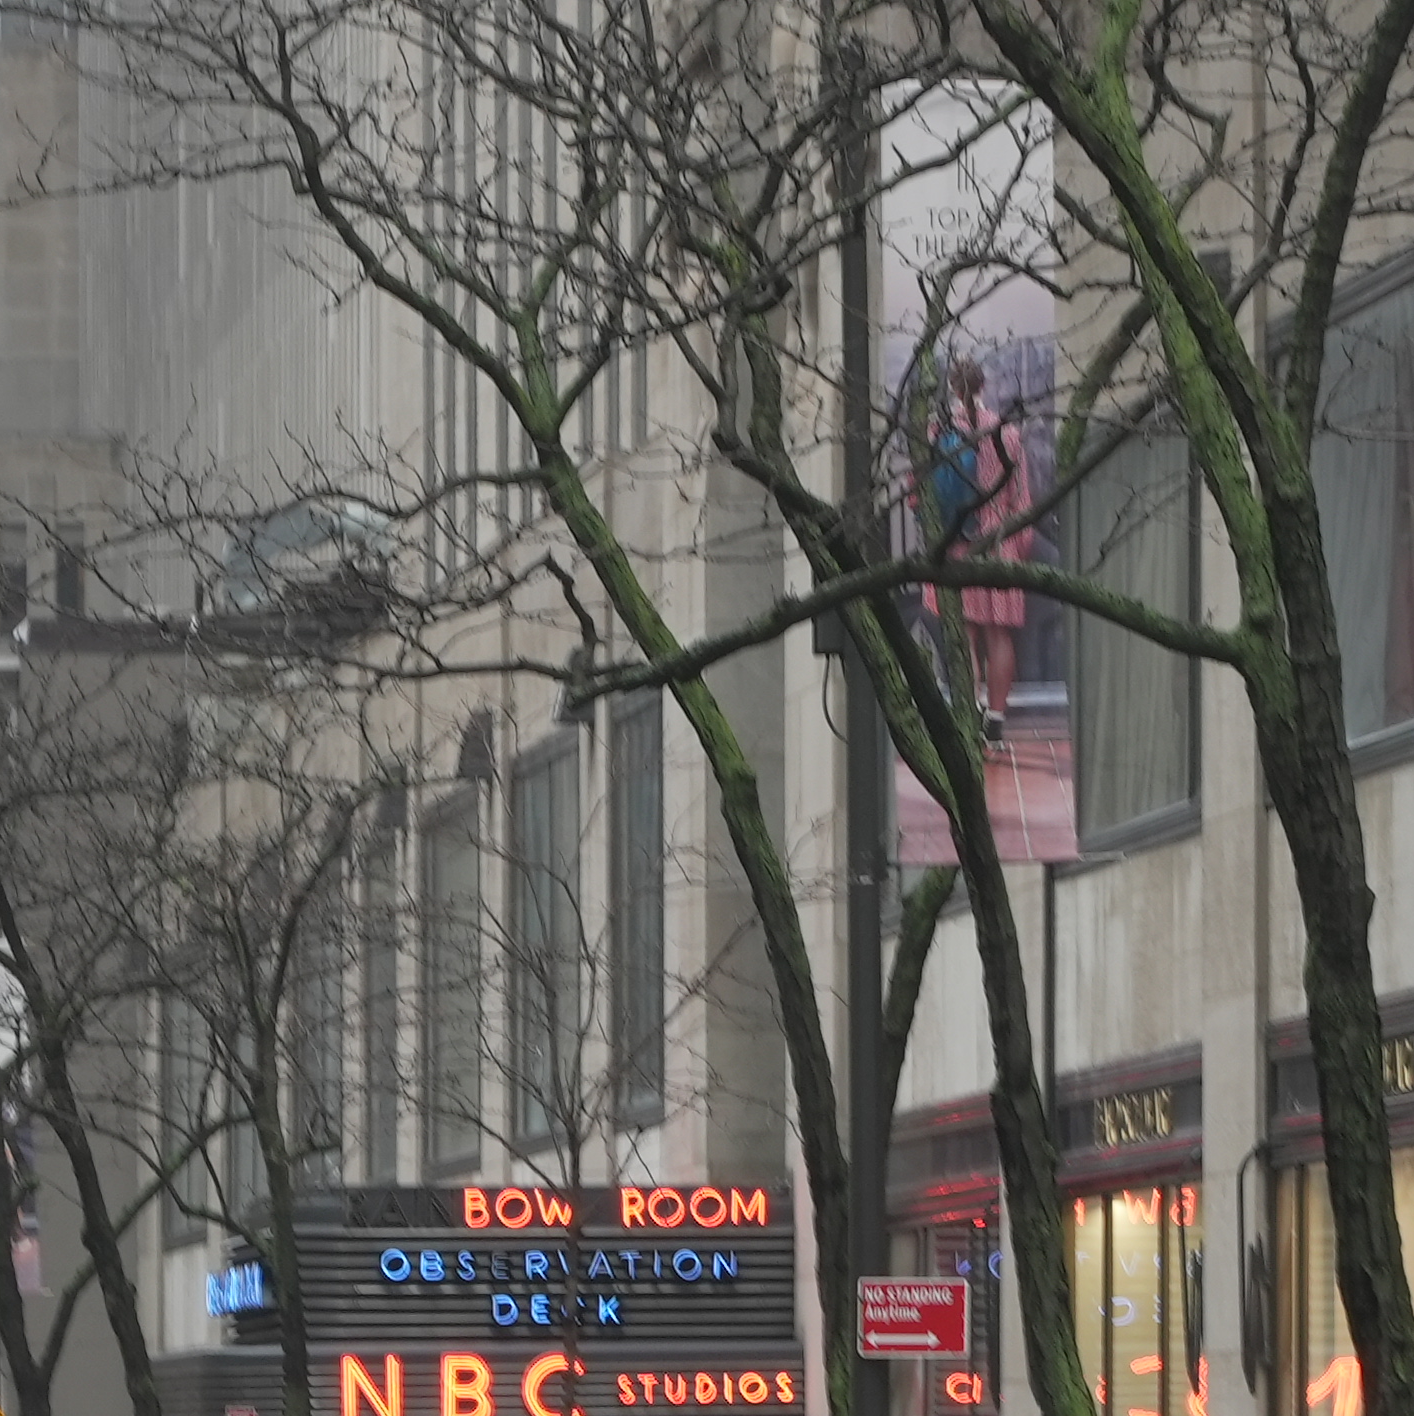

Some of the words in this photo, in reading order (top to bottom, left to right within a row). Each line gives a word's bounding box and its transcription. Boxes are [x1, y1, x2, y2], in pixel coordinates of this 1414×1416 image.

[620, 1185, 769, 1229] ROOM
[887, 1286, 954, 1307] STANDING
[617, 1371, 795, 1406] STUDIOS
